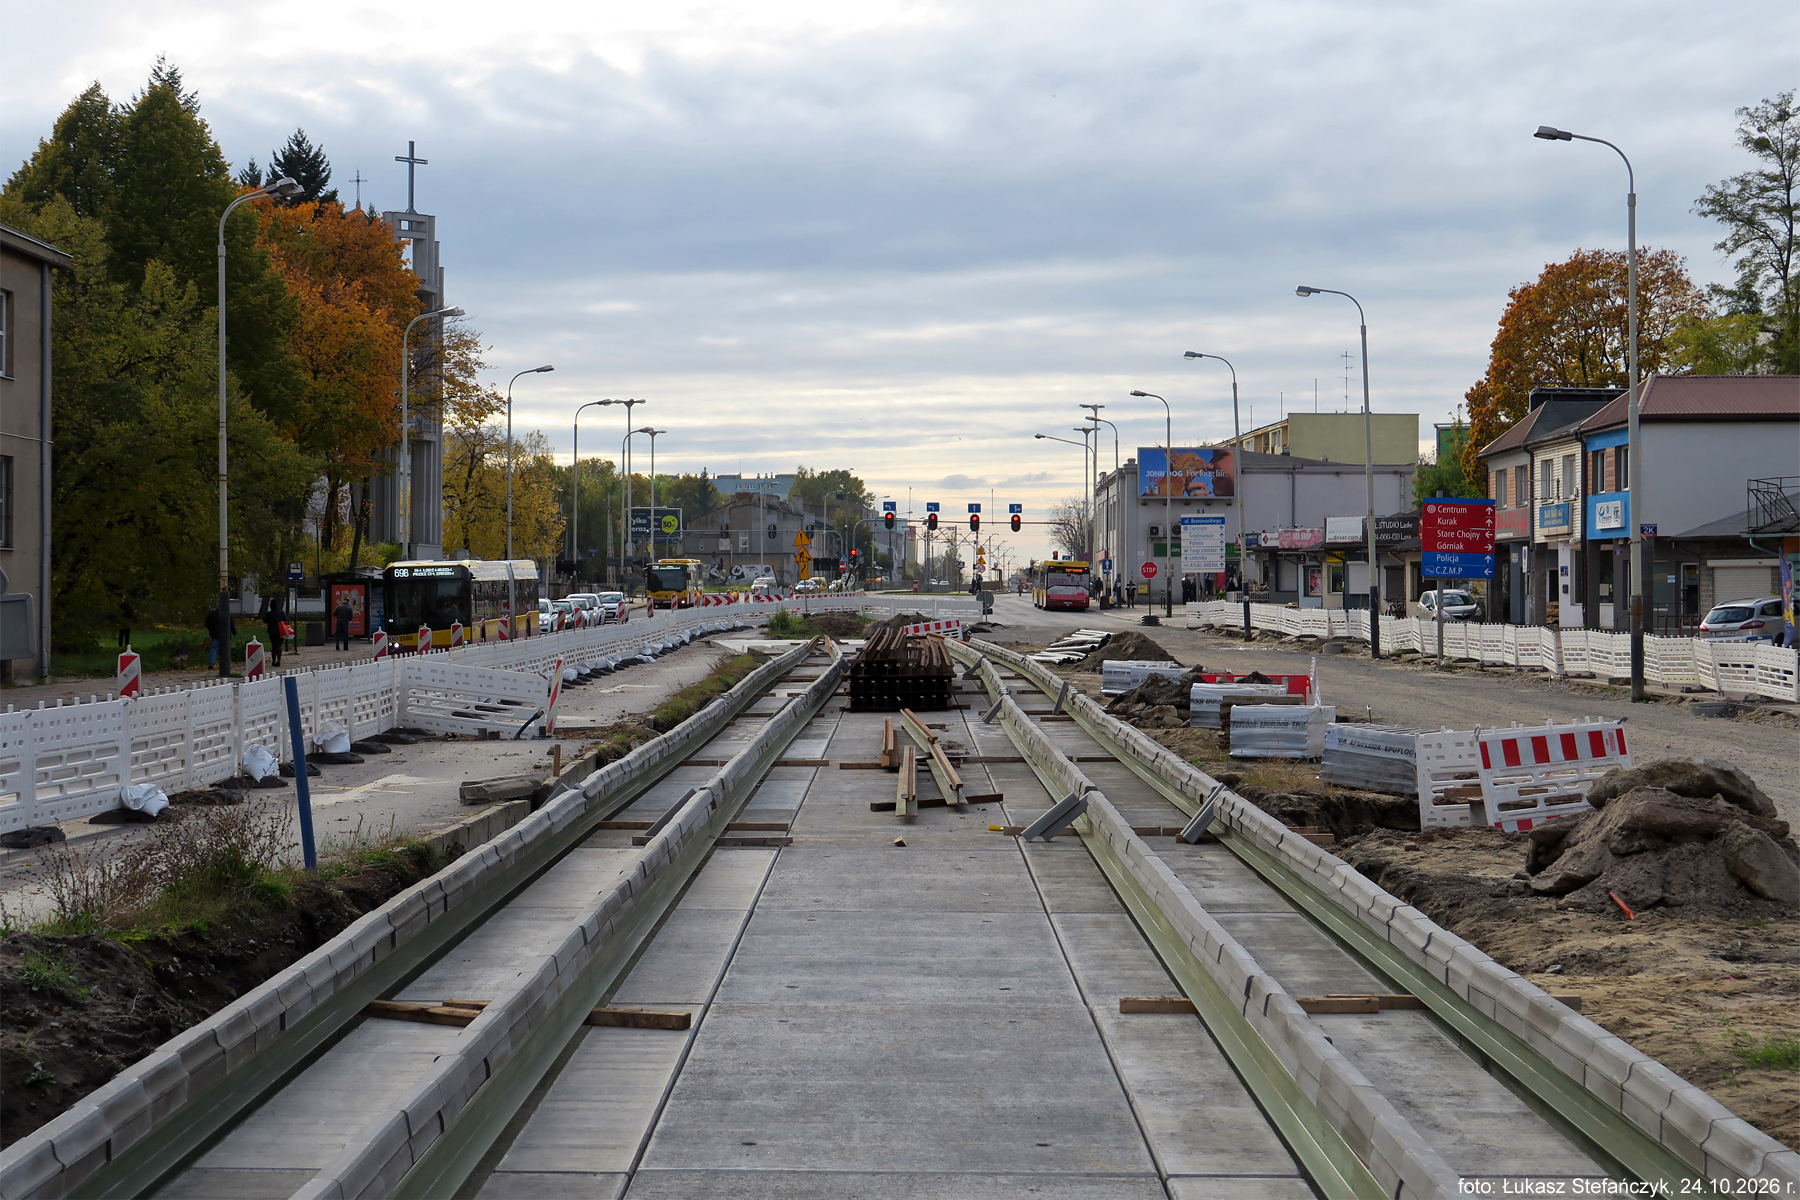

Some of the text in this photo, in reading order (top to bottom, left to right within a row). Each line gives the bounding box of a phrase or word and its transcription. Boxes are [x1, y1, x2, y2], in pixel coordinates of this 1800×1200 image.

[1437, 505, 1467, 514] Centrum
[1379, 521, 1399, 529] STUDIO
[1437, 517, 1457, 525] Kurak
[1643, 526, 1655, 534] 2K
[1437, 530, 1480, 540] Stare Chojny
[1436, 542, 1464, 550] Górniak
[1436, 554, 1459, 564] Policja
[1260, 721, 1289, 729] EPUFLOOR
[1349, 739, 1381, 750] EPUFLOOR
